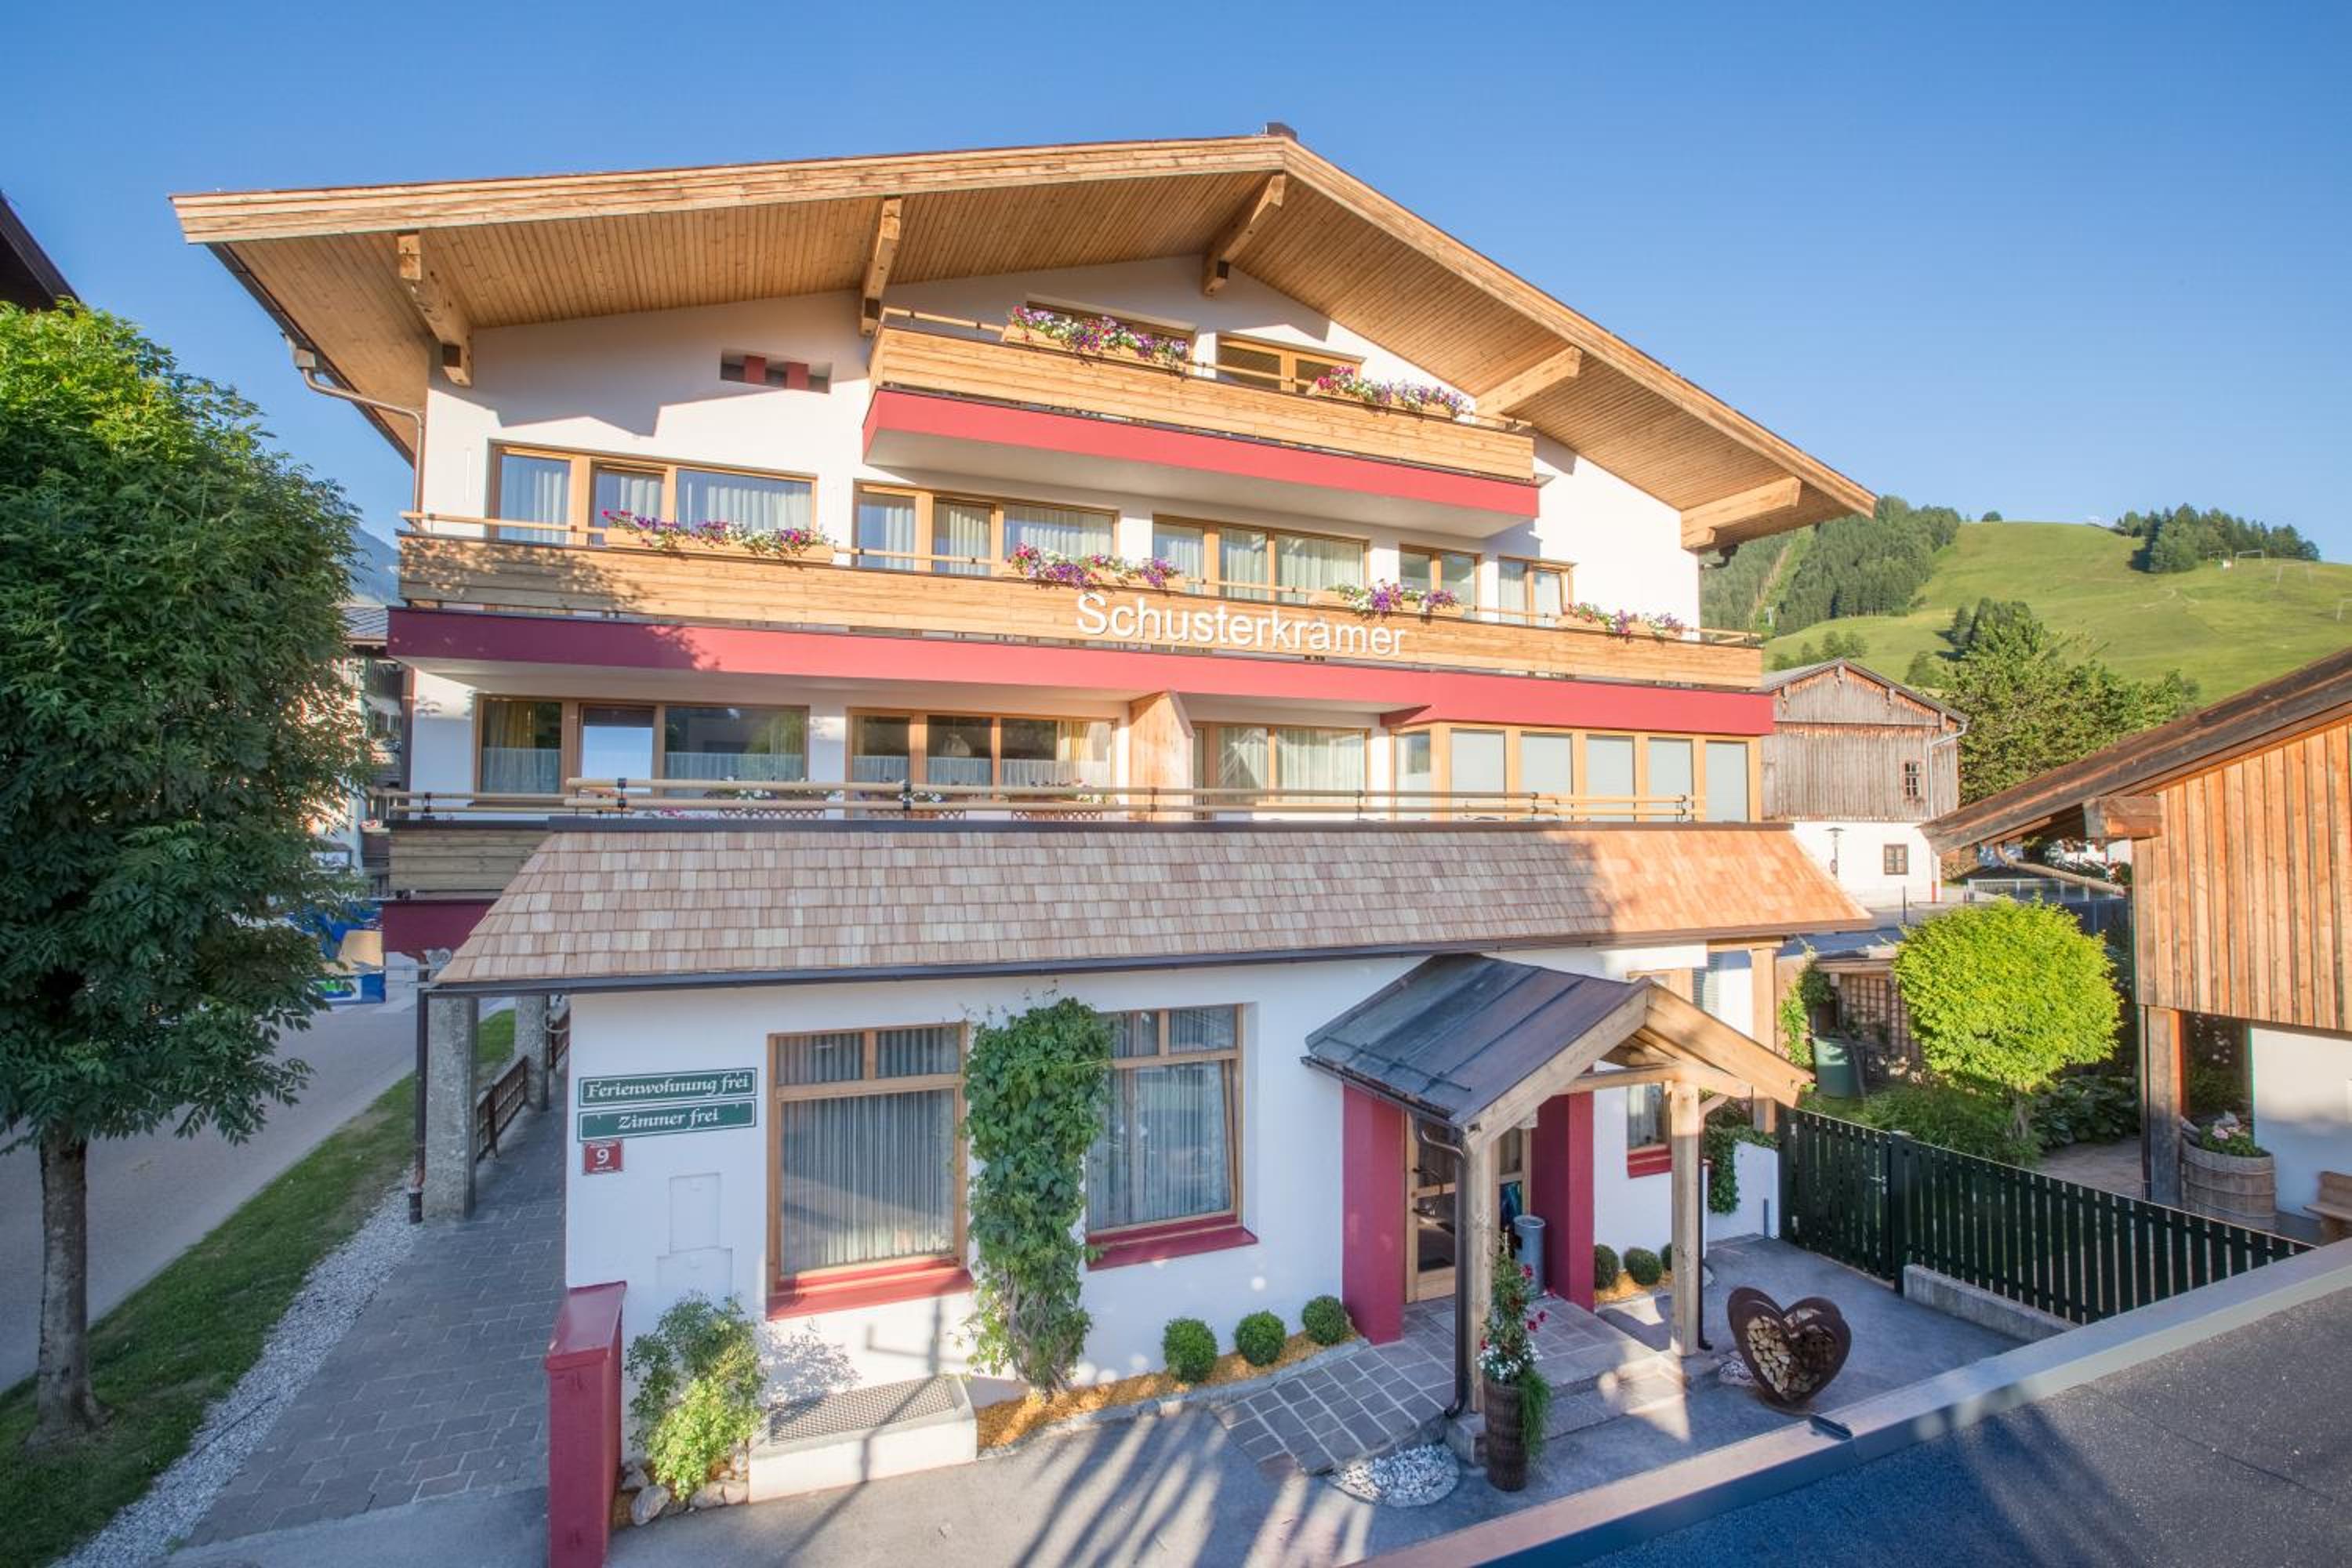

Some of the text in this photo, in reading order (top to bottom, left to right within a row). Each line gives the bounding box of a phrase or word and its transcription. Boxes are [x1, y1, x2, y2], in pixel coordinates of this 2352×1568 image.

[587, 1073, 750, 1098] Ferienwohnung frei
[618, 1108, 720, 1130] Zimmer frei
[596, 1149, 609, 1165] 9
